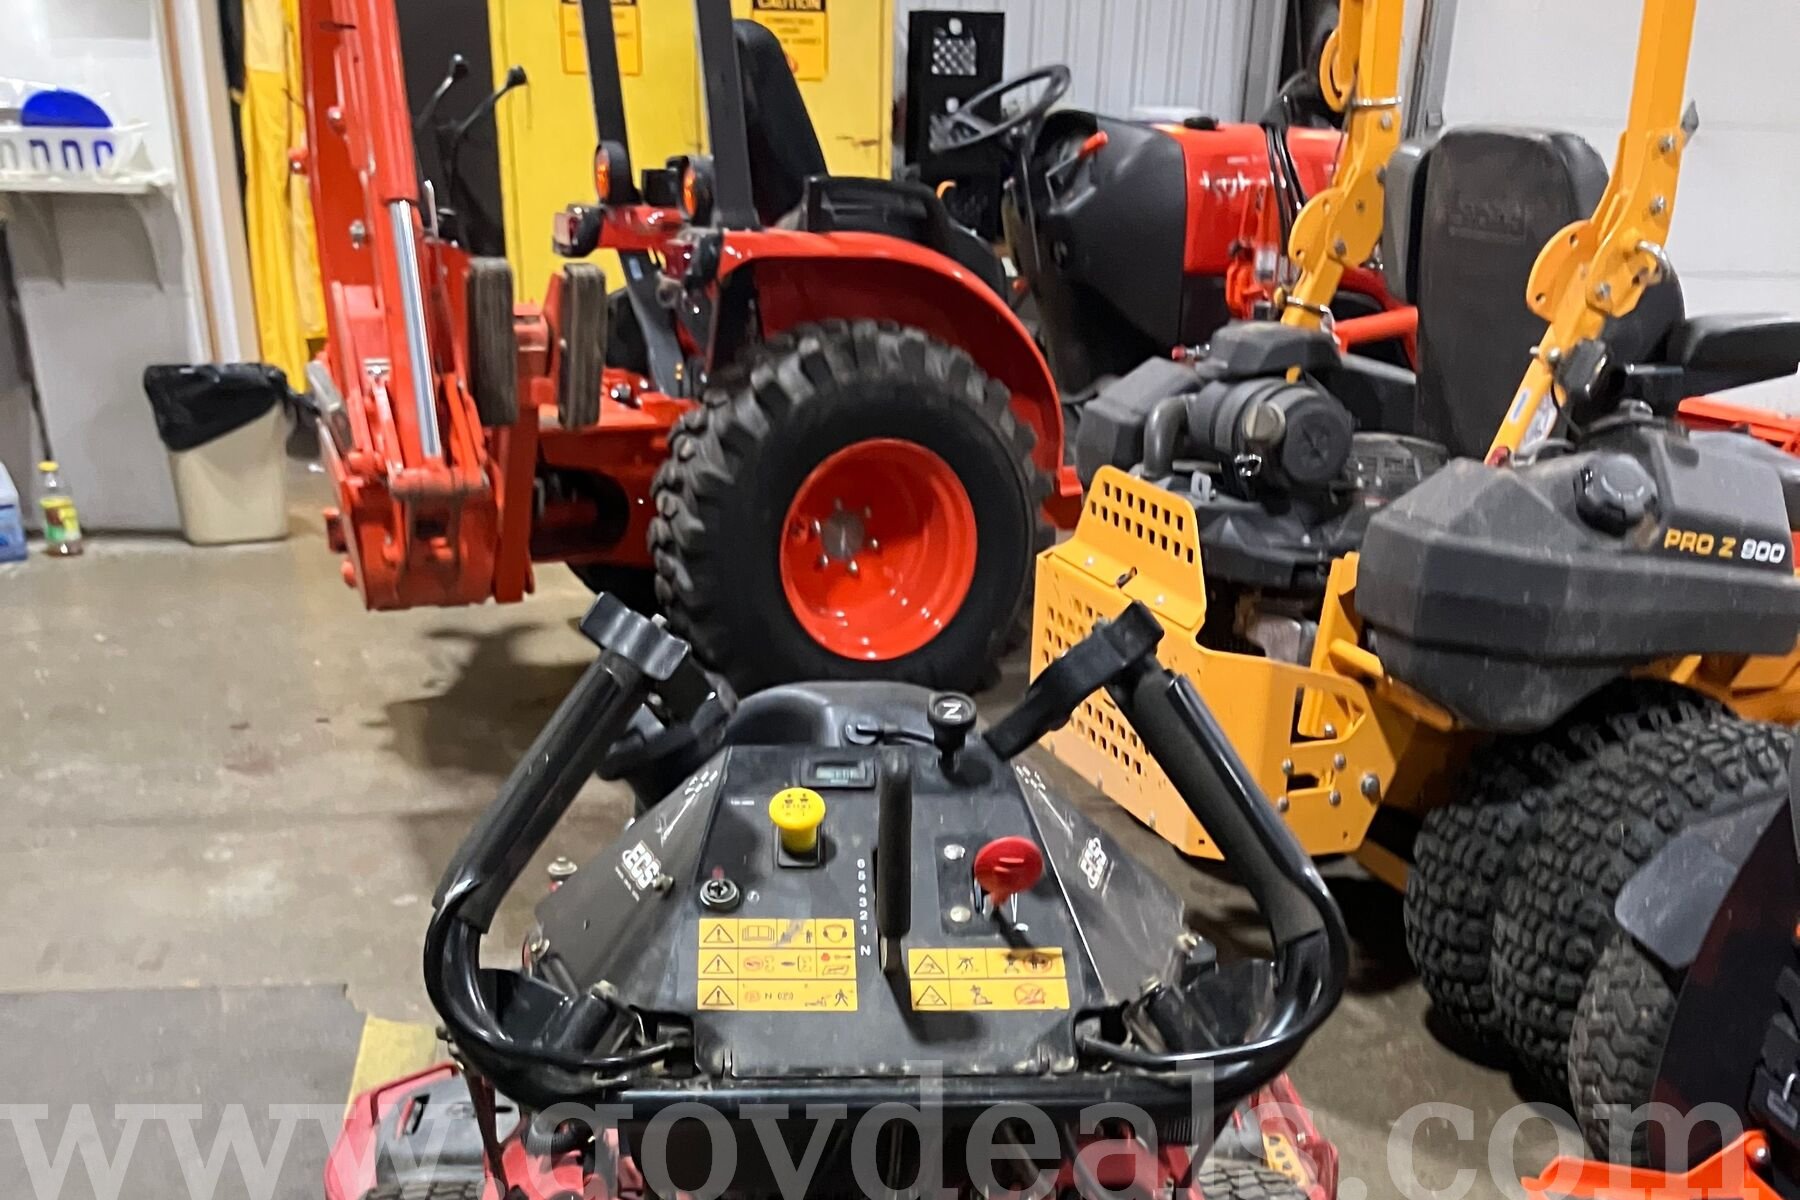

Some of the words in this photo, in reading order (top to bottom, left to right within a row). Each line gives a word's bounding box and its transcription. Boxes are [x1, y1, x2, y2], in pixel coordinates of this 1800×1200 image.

[1664, 528, 1714, 555] PRO
[1718, 536, 1736, 558] Z
[860, 945, 871, 956] N
